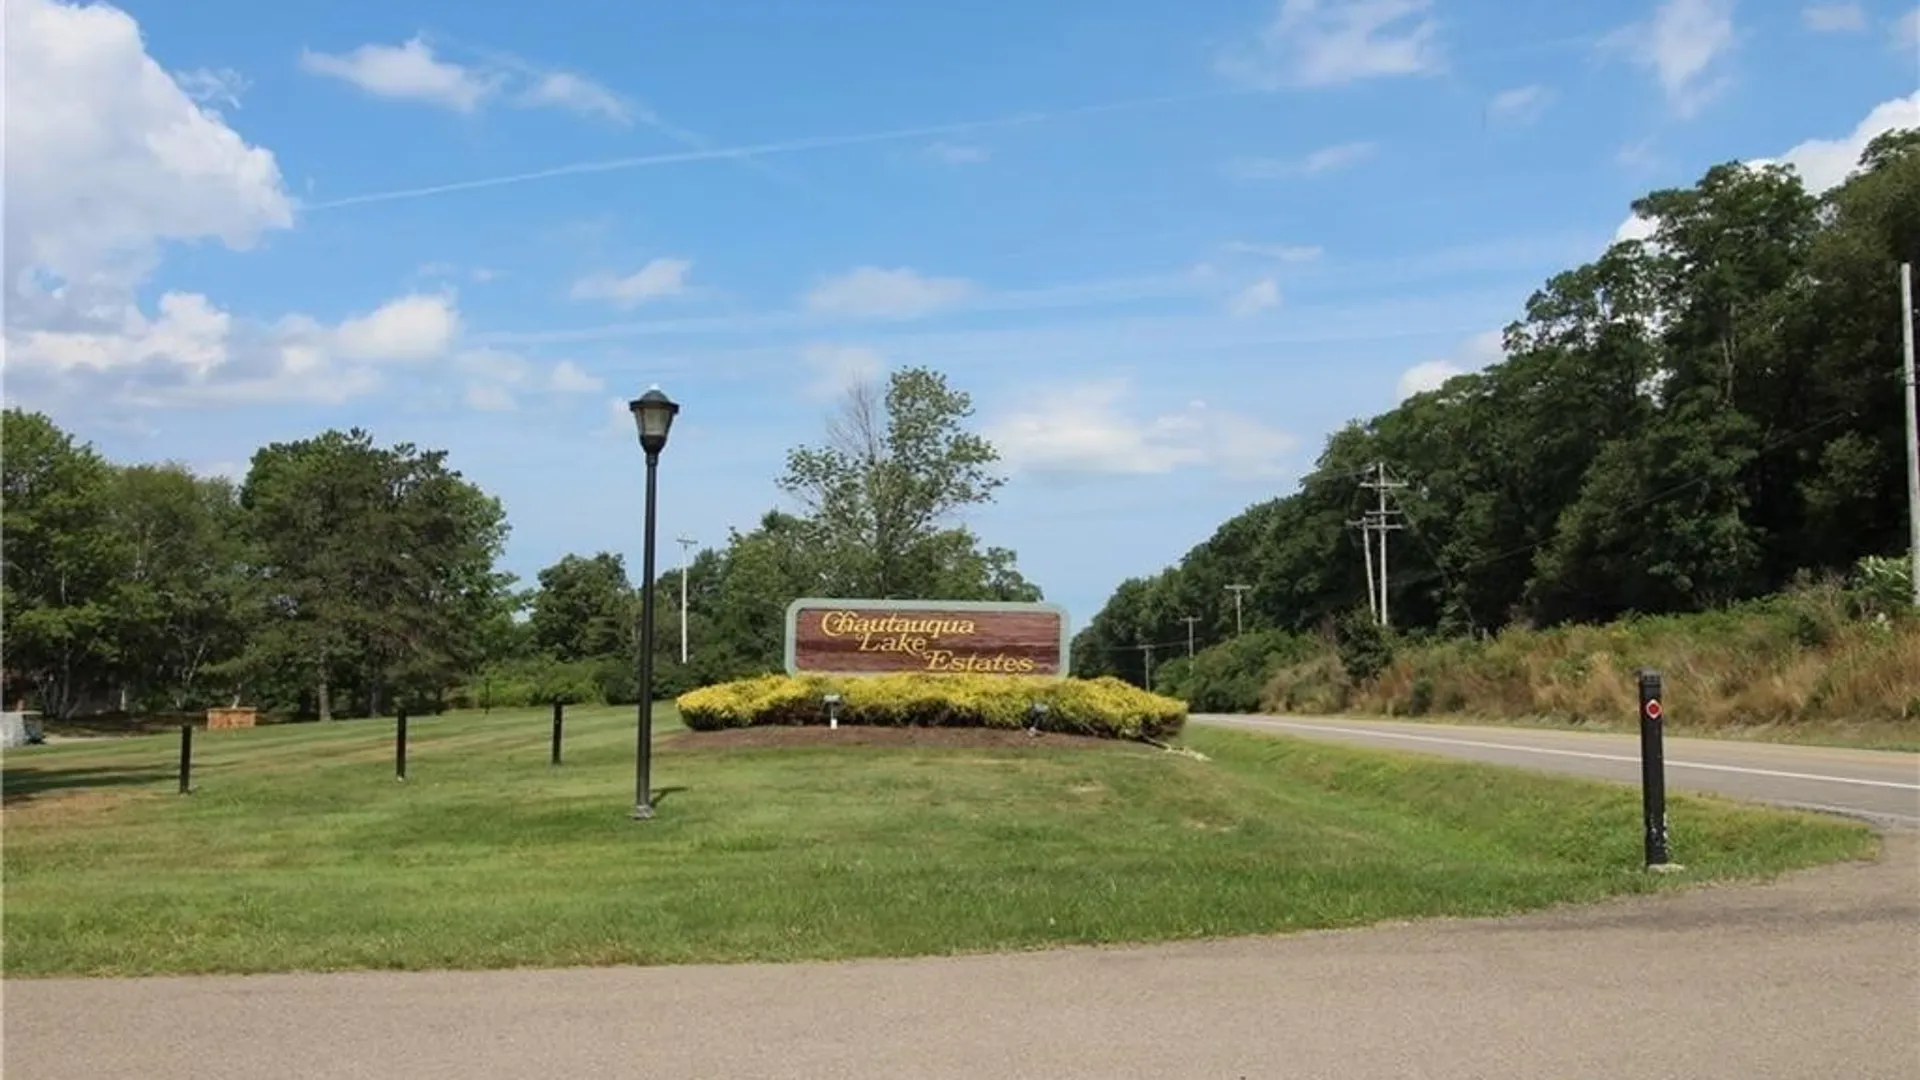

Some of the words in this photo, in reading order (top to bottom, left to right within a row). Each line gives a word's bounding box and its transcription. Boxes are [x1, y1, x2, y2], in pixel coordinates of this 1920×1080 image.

[821, 611, 976, 638] Chautauqua
[857, 632, 927, 655] Lake
[924, 650, 1034, 672] Estates
